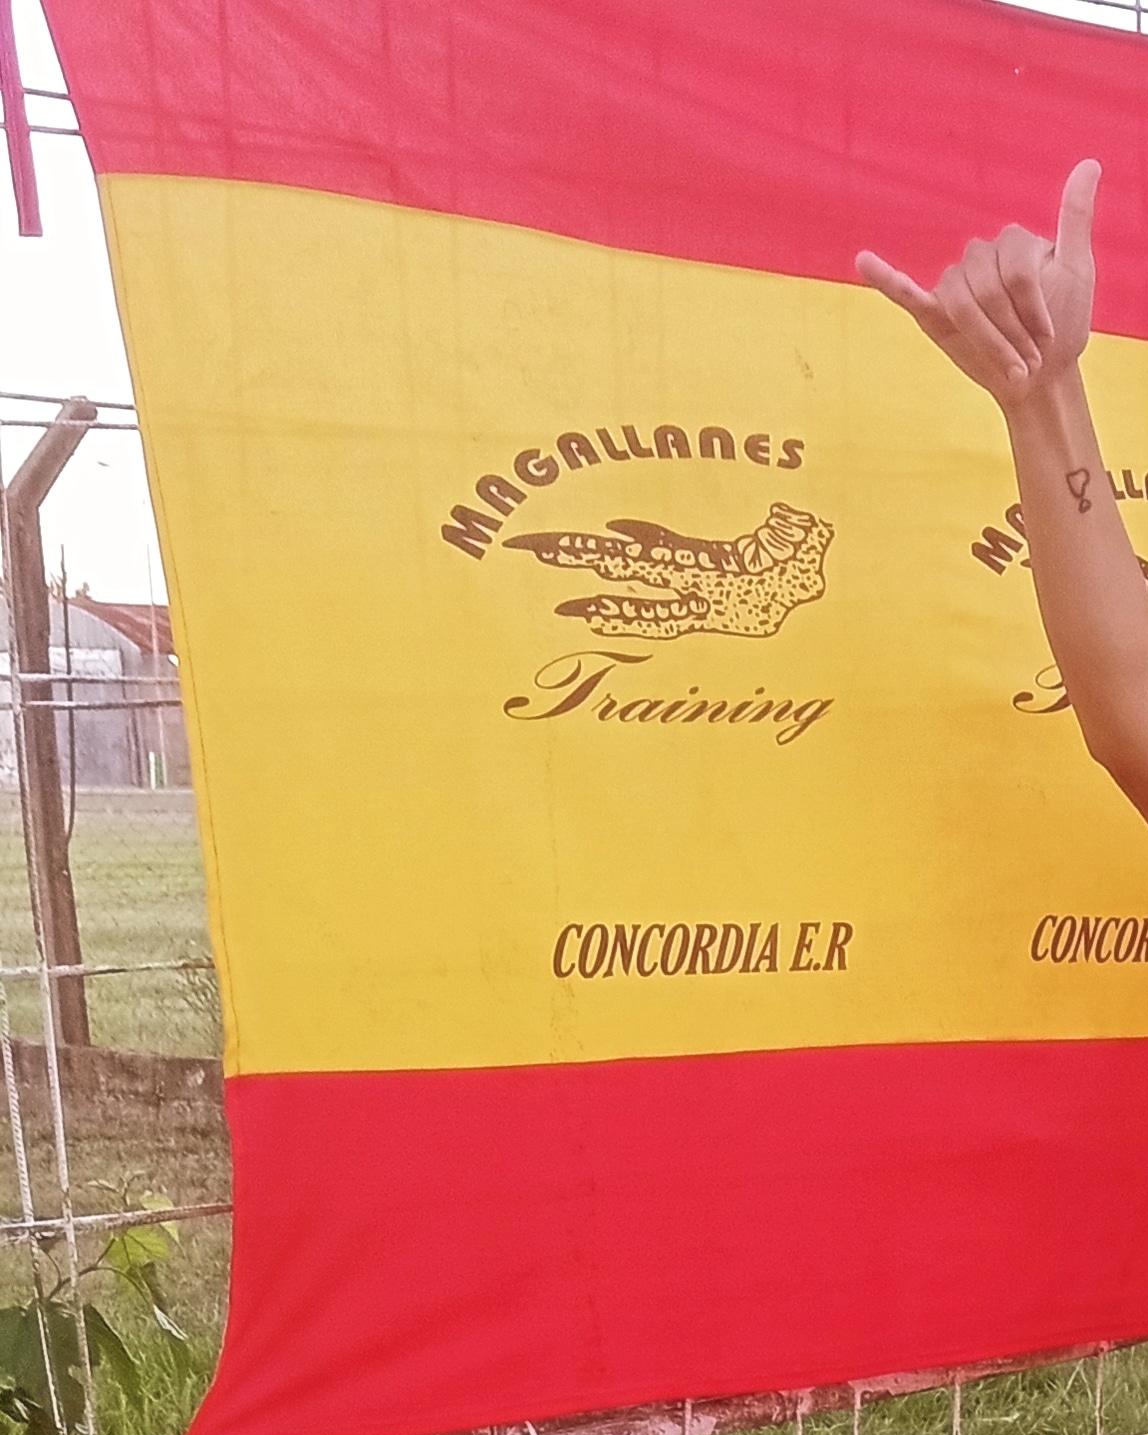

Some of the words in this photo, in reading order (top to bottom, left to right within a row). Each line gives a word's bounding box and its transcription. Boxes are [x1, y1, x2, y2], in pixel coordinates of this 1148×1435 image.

[441, 425, 805, 561] MAGALLANES
[503, 650, 834, 746] Training
[553, 922, 779, 979] CONCORDIA
[789, 921, 854, 971] E.R
